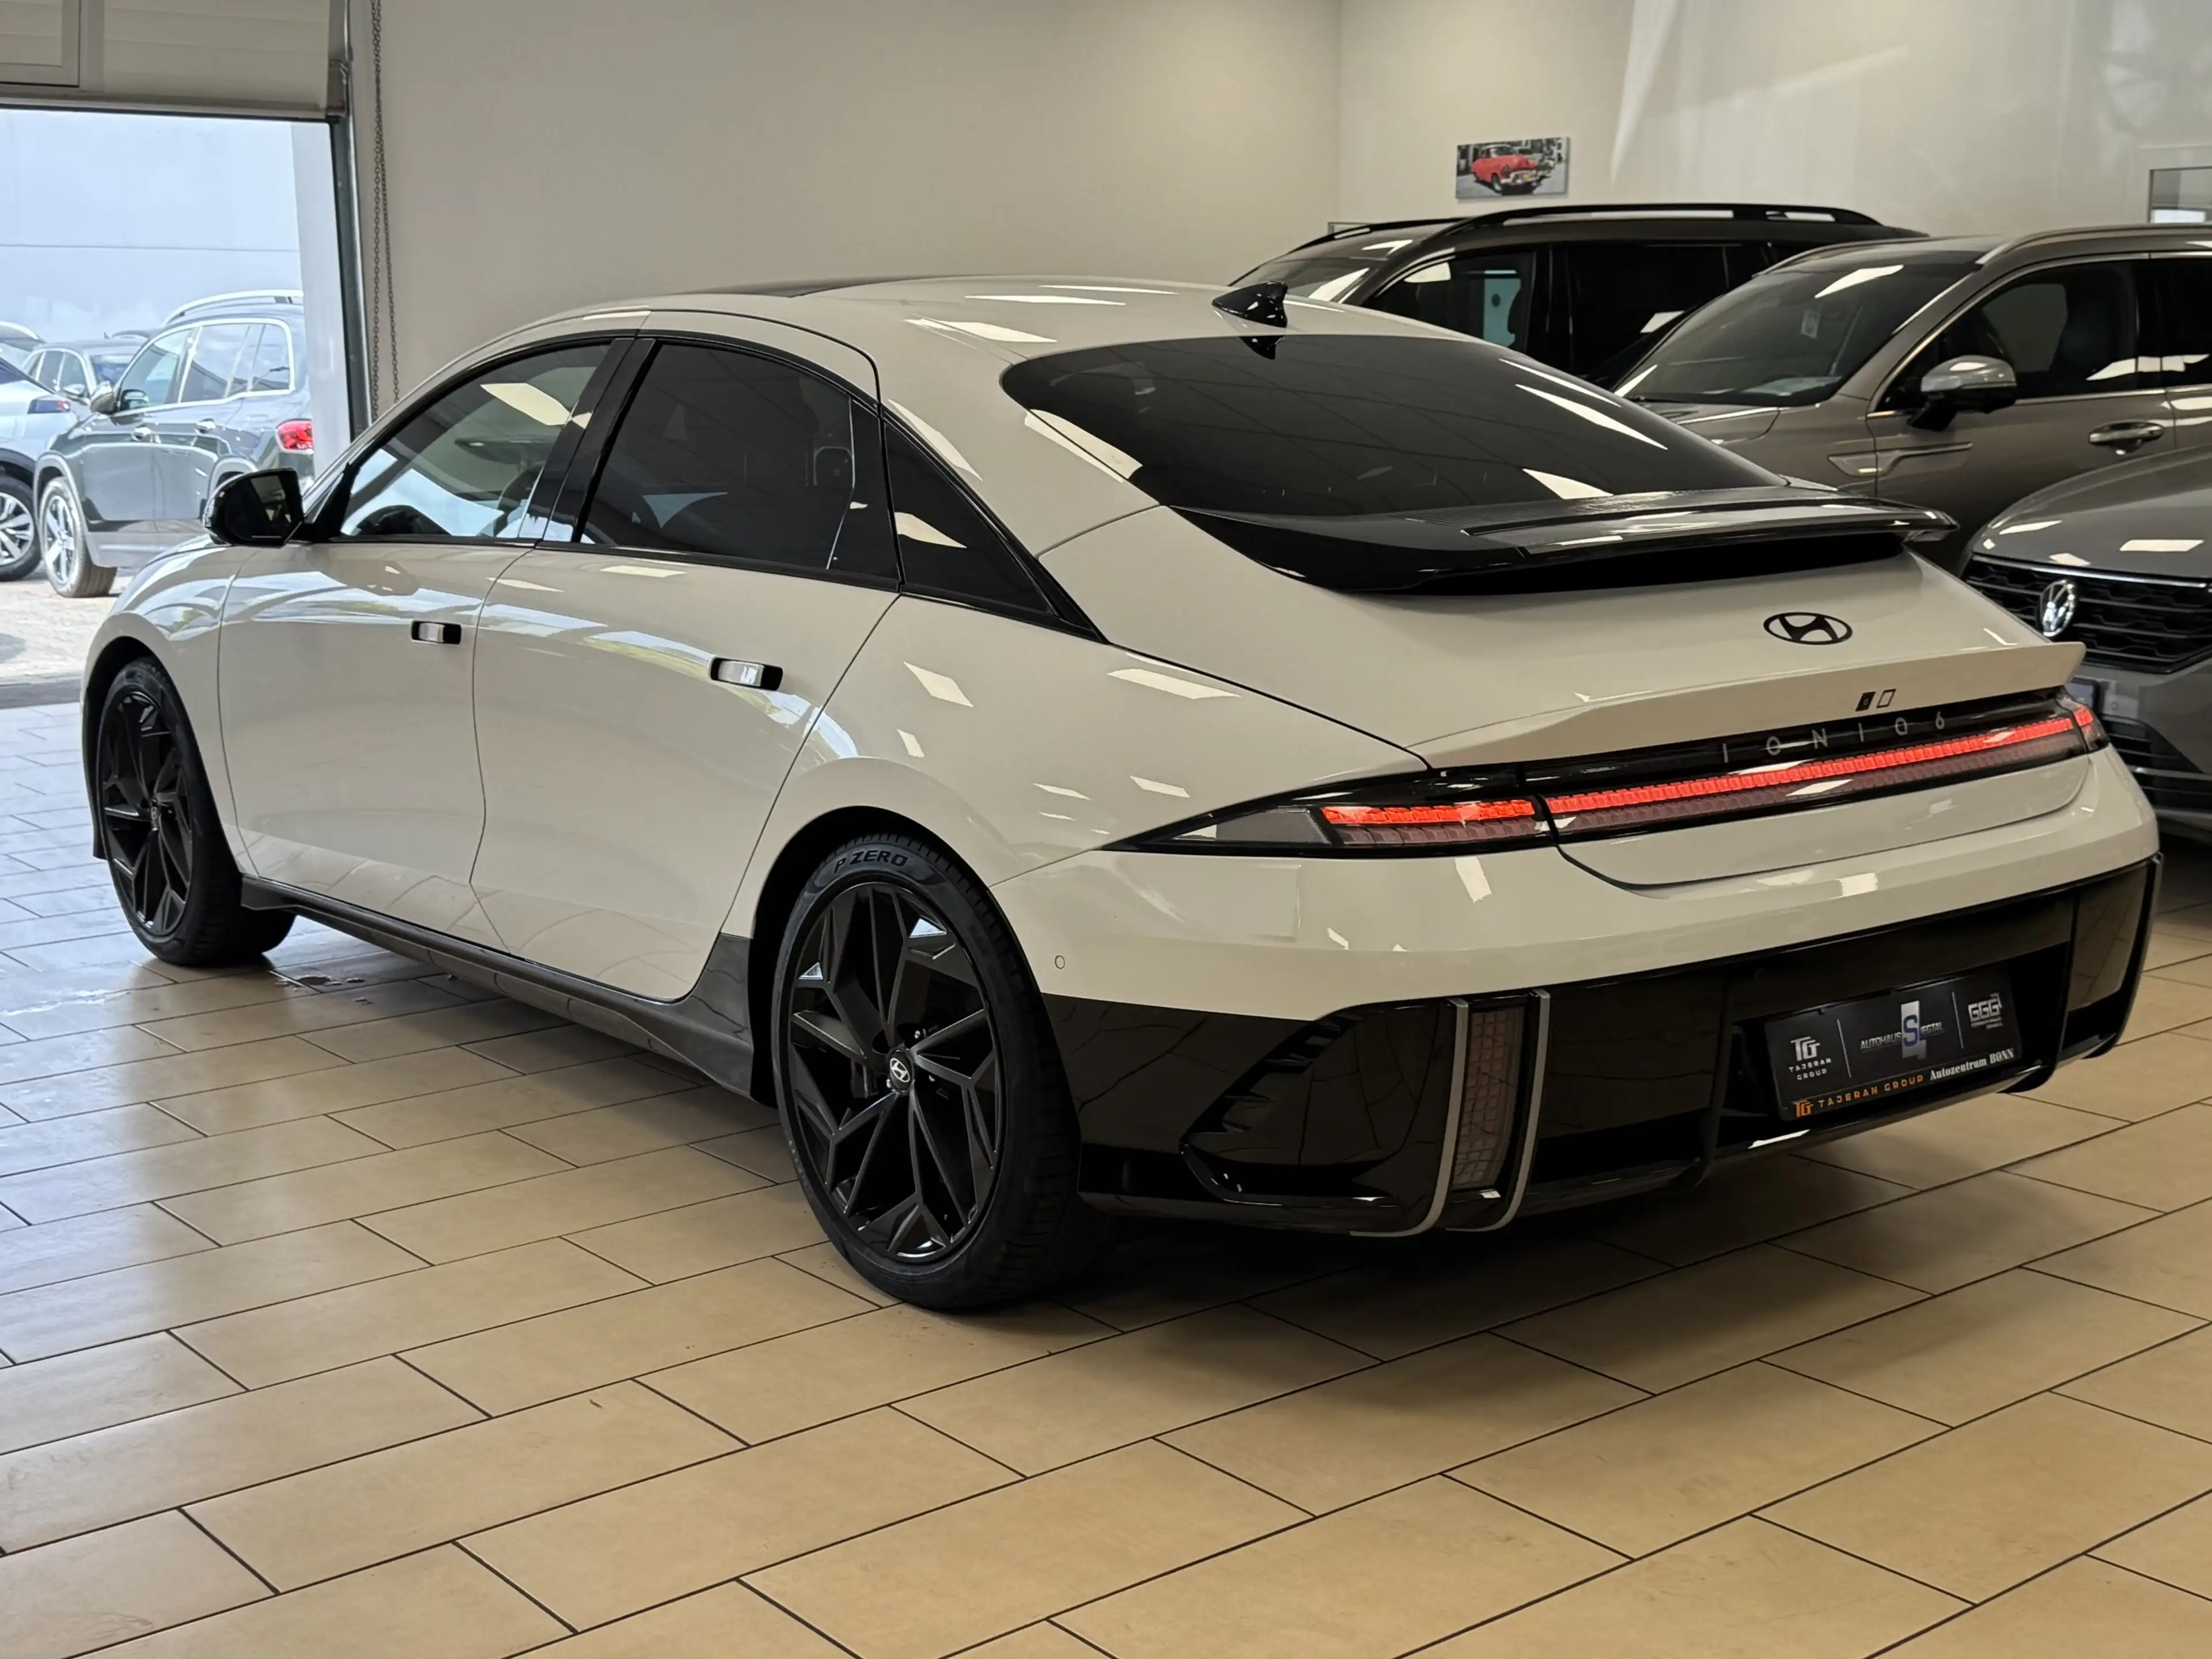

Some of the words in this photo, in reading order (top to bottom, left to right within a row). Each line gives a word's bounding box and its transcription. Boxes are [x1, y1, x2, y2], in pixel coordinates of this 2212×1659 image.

[834, 857, 847, 874] P
[849, 850, 909, 866] ZERO
[1884, 1074, 1924, 1092] GROUP
[1930, 1058, 1987, 1081] Autozentrum
